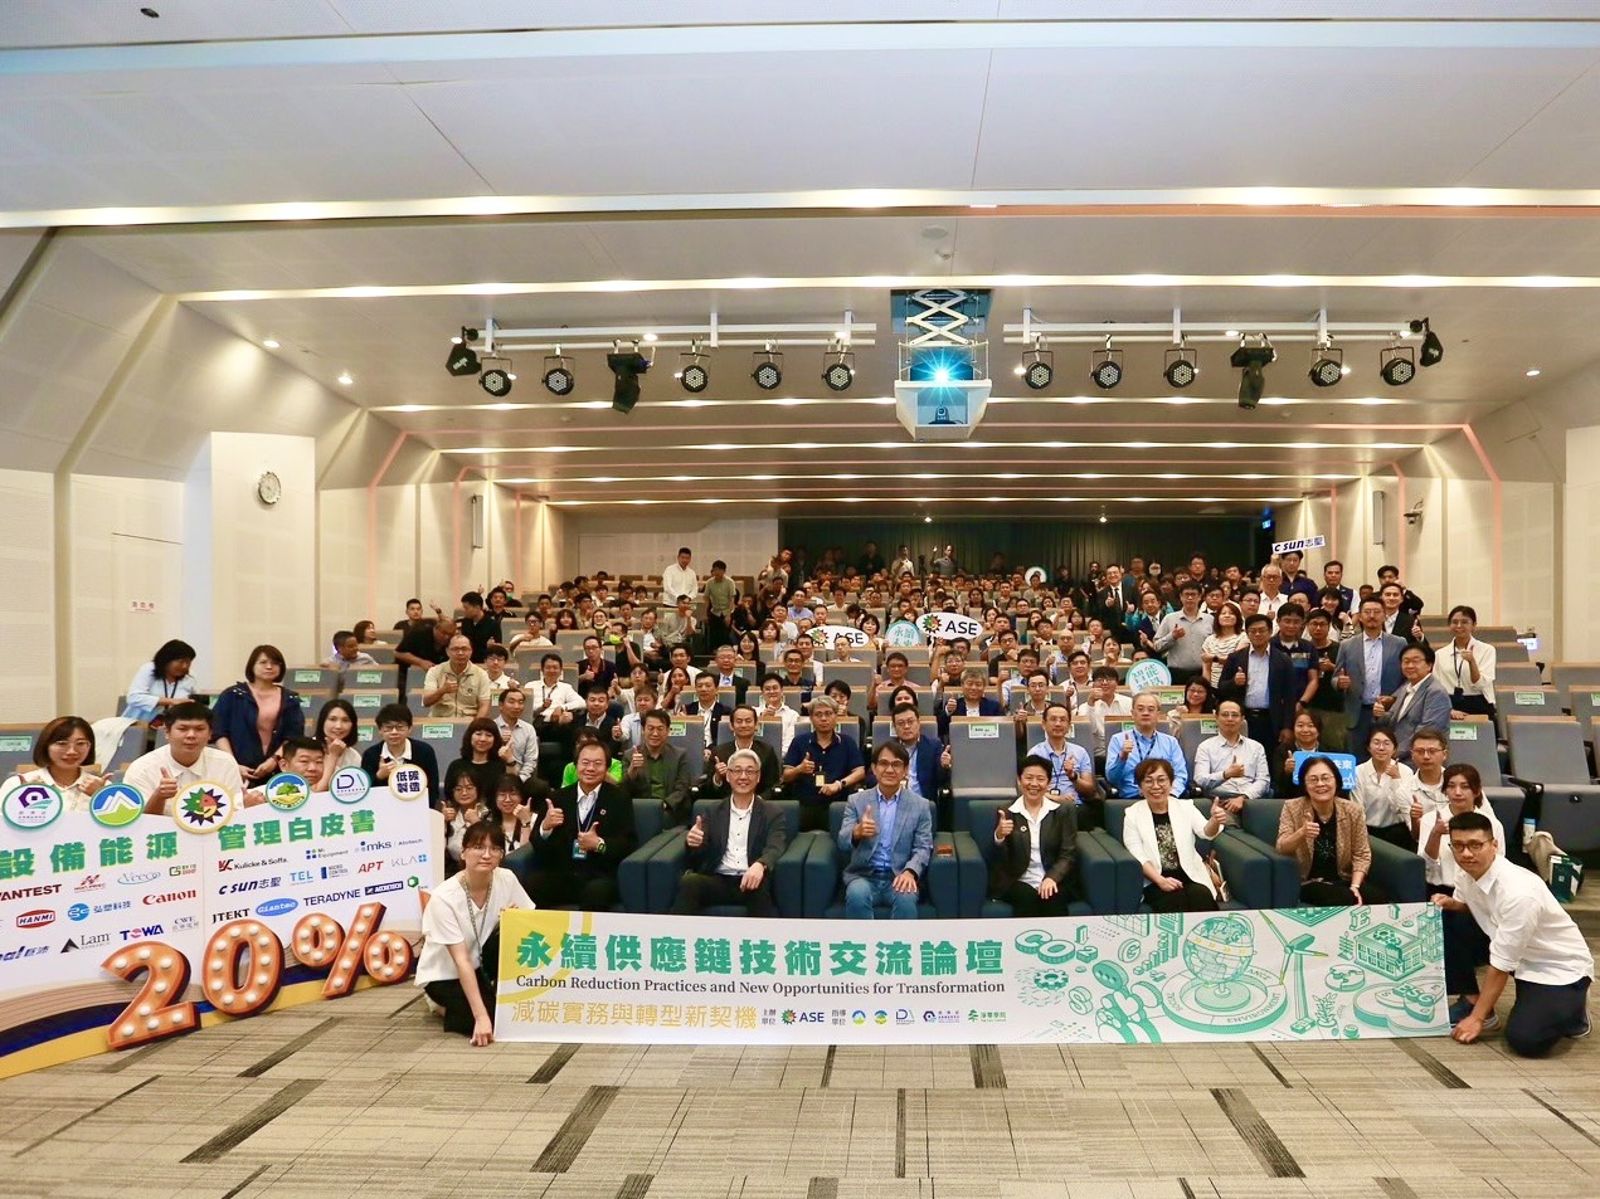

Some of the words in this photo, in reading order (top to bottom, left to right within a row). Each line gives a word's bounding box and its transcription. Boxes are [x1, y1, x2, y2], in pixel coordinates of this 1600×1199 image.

[945, 621, 978, 635] ASE
[396, 771, 419, 781] 低碳
[218, 809, 375, 851] 管理白皮書
[234, 862, 260, 870] Kulicke
[358, 860, 384, 874] APT
[290, 870, 314, 881] TEL
[0, 884, 62, 901] ANTEST
[142, 889, 197, 905] Canon
[303, 889, 361, 907] TERADYNE
[19, 914, 53, 924] HANMI
[212, 908, 250, 923] JTEKT
[81, 933, 110, 945] Lam
[120, 925, 164, 941] TOWA
[516, 931, 1005, 976] 永續供應鏈技術交流論壇
[101, 901, 413, 1050] 20%
[516, 974, 567, 989] Carbon
[570, 976, 641, 992] Reduction
[643, 979, 707, 993] Practices
[709, 981, 736, 994] and
[739, 980, 771, 994] New
[772, 981, 870, 997] Opportunities
[873, 982, 894, 994] for
[896, 980, 1006, 994] Transformation
[511, 1000, 758, 1029] 減碳實務與轉型新契機
[799, 1012, 825, 1023] ASE
